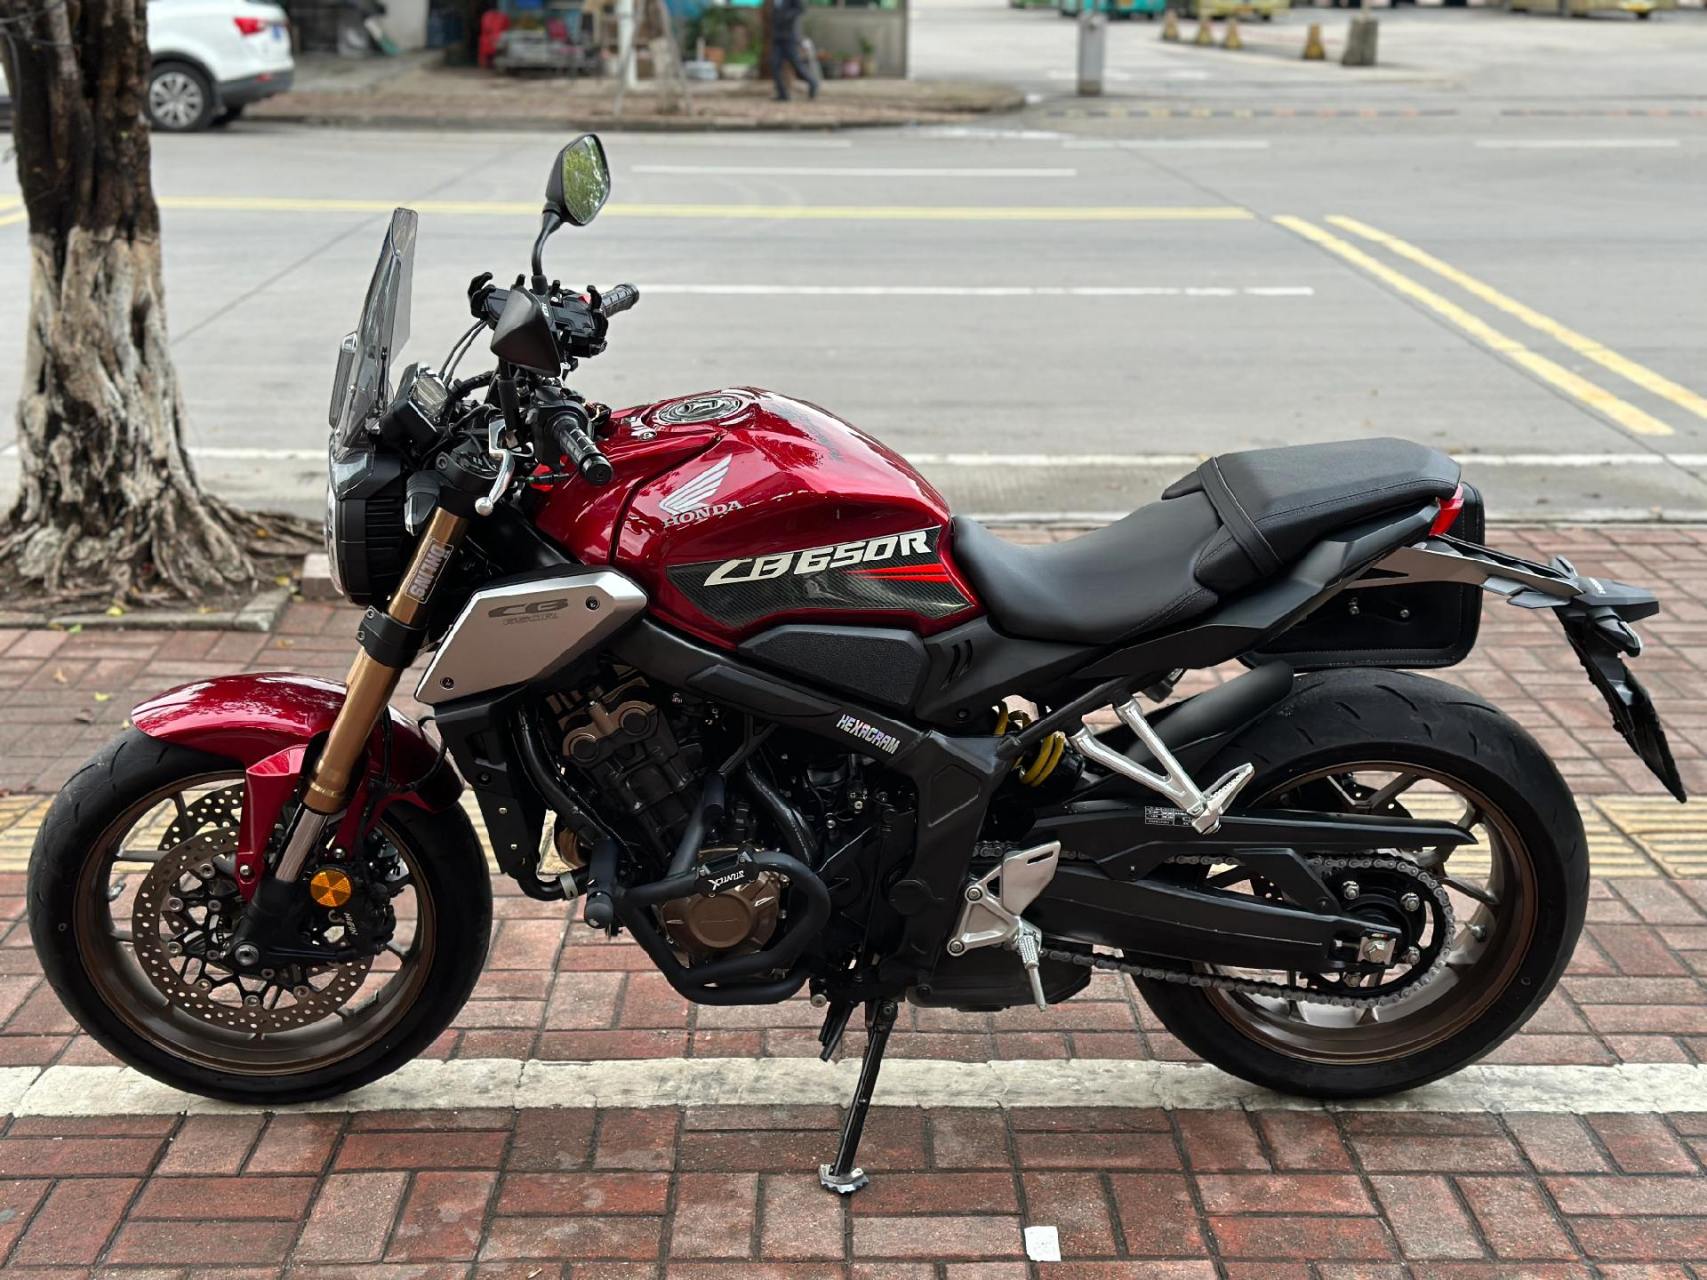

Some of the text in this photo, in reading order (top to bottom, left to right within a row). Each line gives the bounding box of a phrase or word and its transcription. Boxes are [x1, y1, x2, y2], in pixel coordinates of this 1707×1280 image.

[663, 500, 744, 528] HONDA
[488, 598, 568, 618] CB
[836, 713, 900, 754] HEXAGRAM
